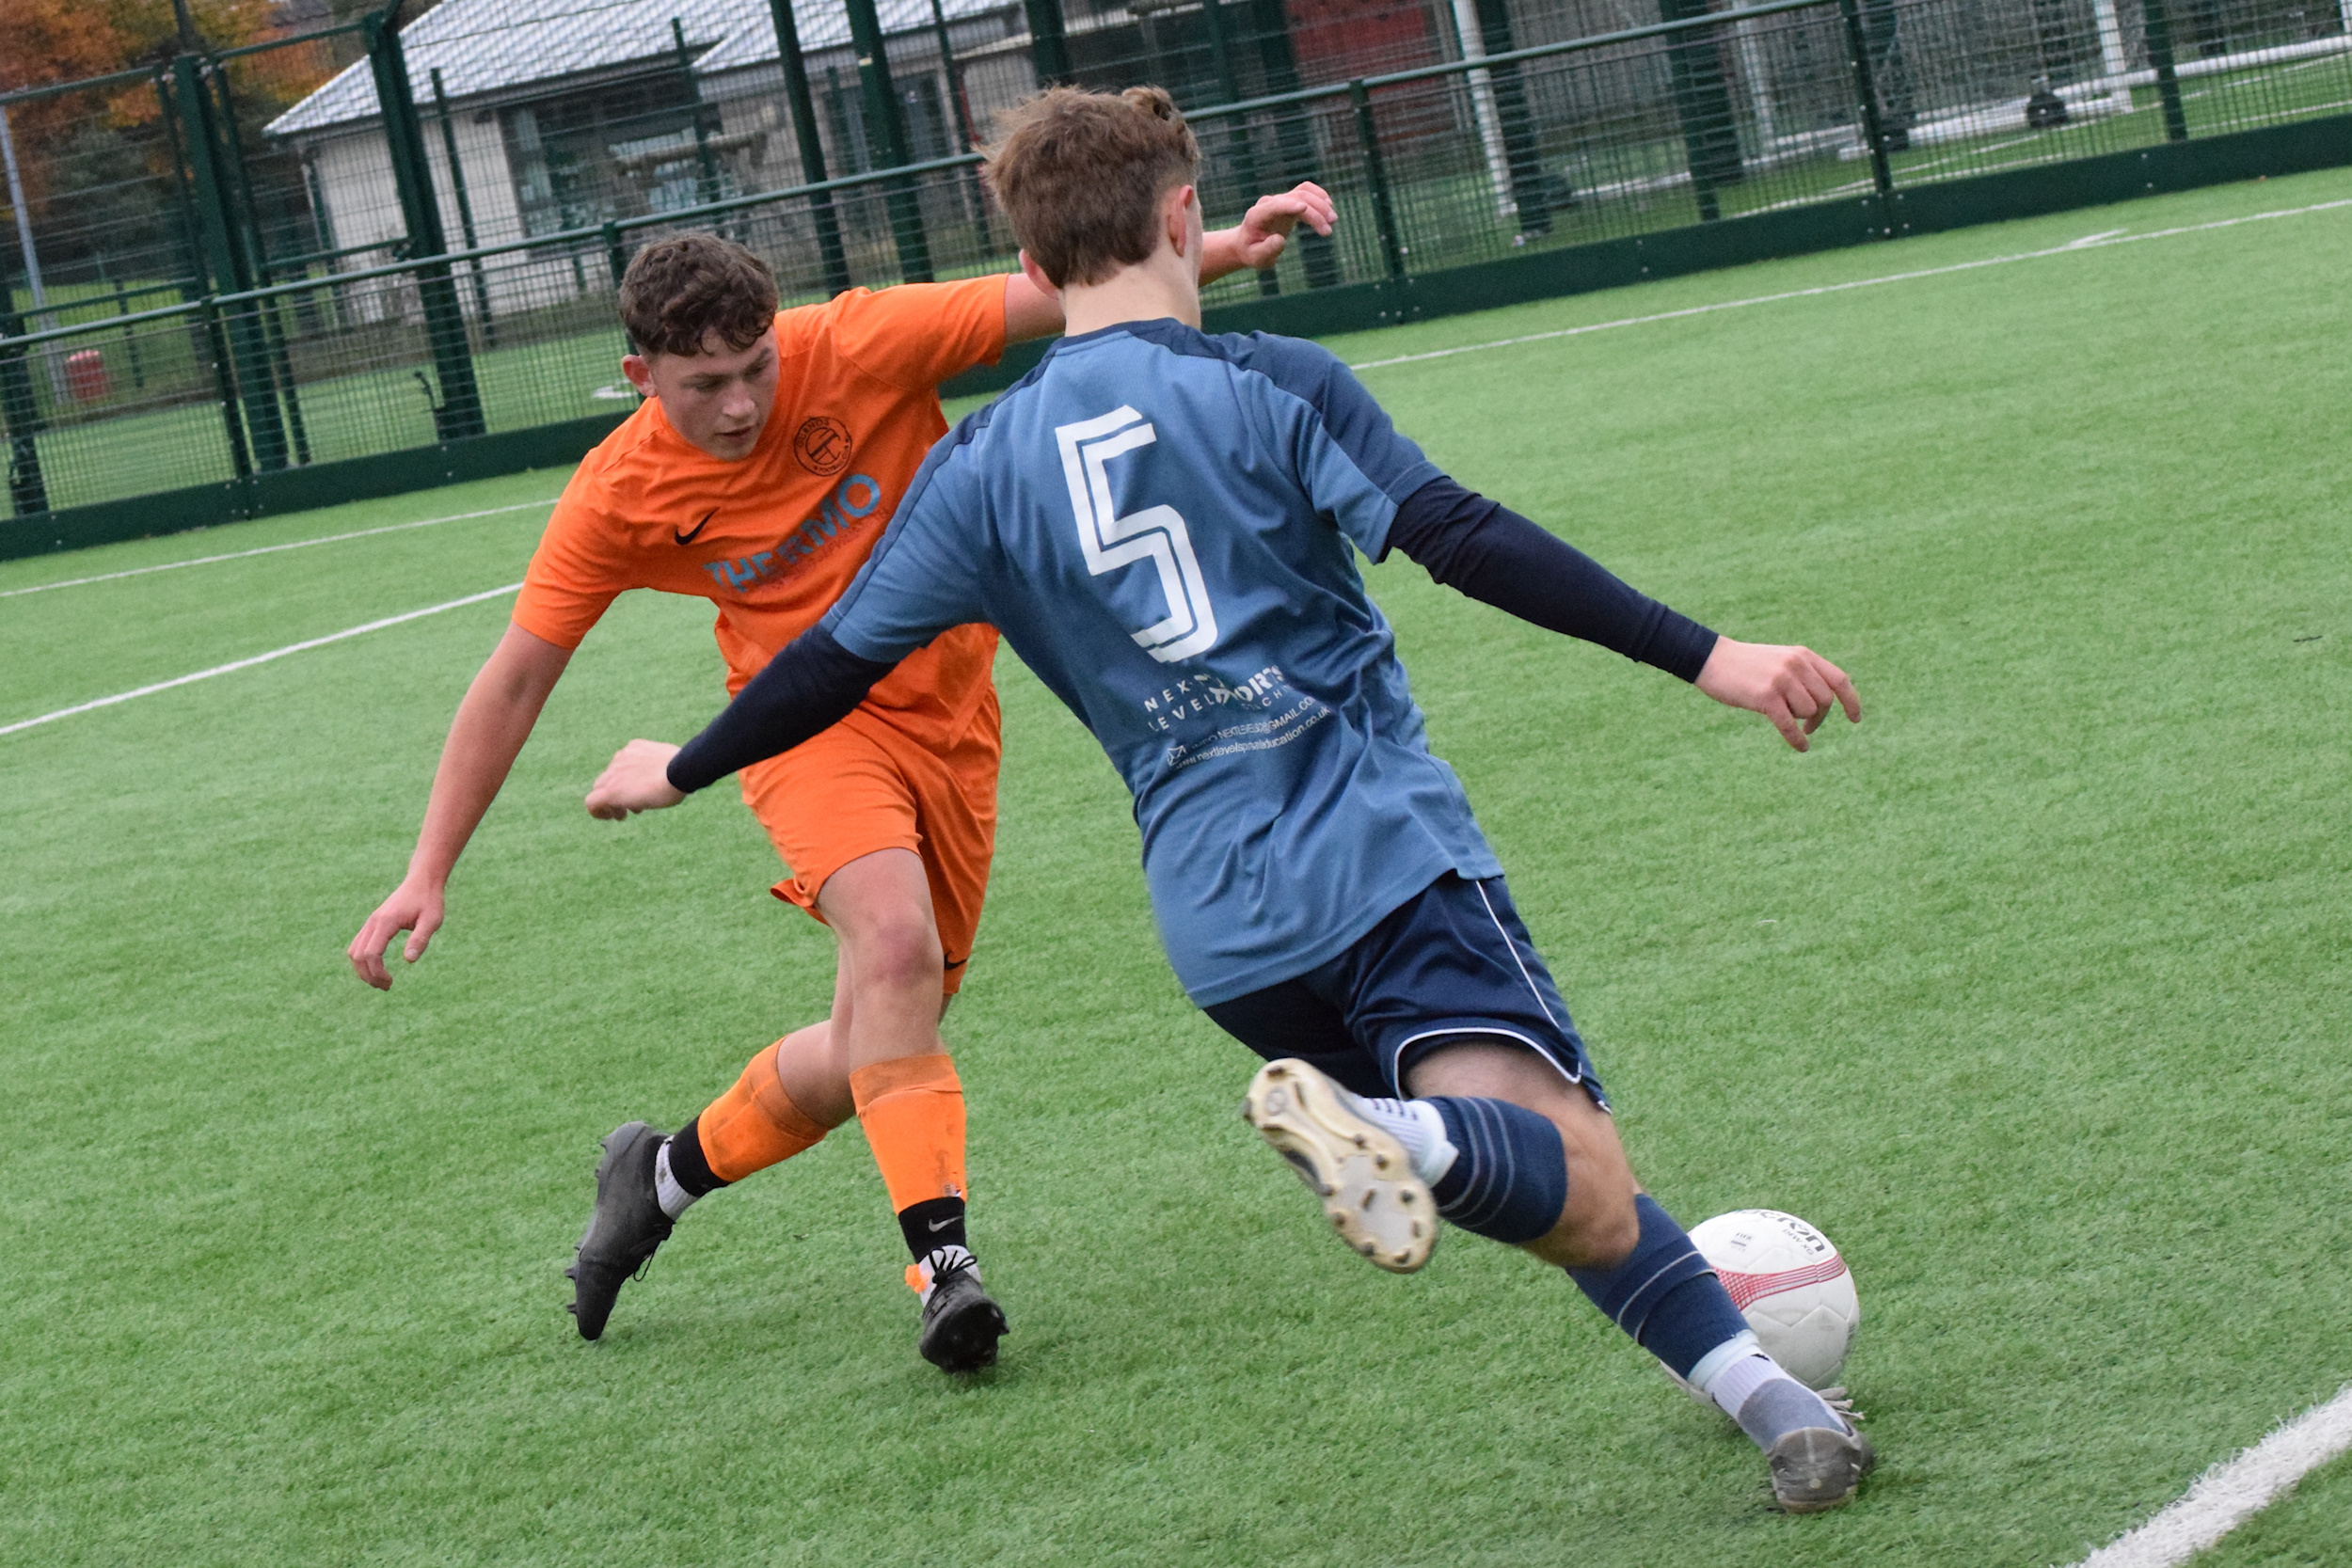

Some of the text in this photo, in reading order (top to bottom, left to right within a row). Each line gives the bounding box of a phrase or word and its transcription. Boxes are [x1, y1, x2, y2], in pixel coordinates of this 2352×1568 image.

[703, 473, 881, 593] THERMO
[1055, 404, 1217, 663] 5
[1144, 679, 1192, 712] NEX
[1148, 694, 1215, 732] LEVEL
